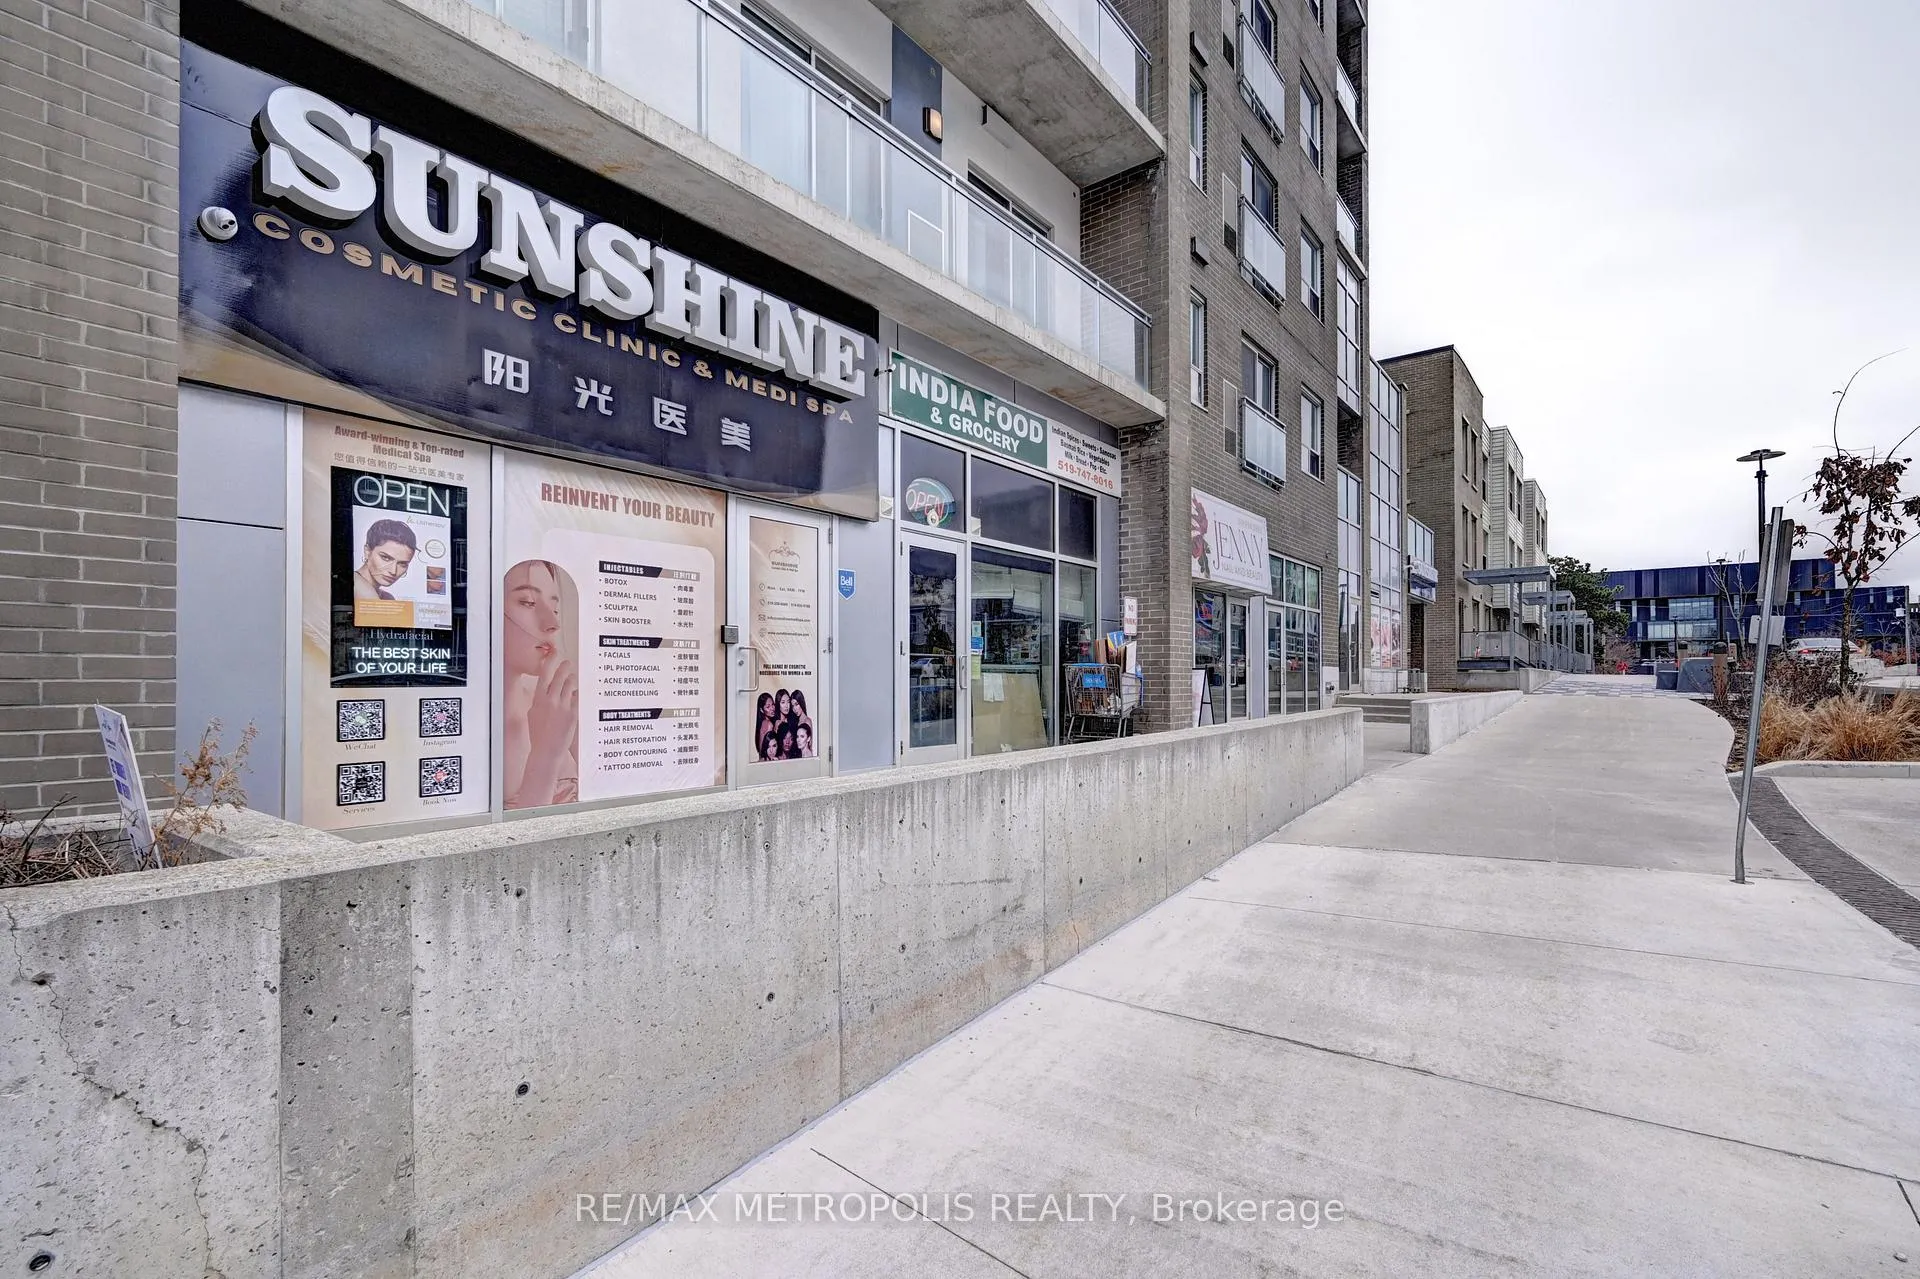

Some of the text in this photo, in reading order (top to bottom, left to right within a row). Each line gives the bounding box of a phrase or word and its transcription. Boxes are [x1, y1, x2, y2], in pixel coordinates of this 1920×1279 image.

[263, 84, 866, 404] SUNSHINE
[253, 212, 854, 425] COSMETIC CLINIC & MEDI SPA
[483, 350, 752, 452] 阳光医美
[900, 362, 1044, 444] INDIA FOOD
[931, 407, 1020, 453] & GROCERY
[335, 426, 409, 450] Award-winning
[421, 442, 464, 458] Top-rated
[1052, 426, 1116, 460] Indian Spices Sweets Samosas
[373, 444, 431, 463] Medical Spa
[1065, 451, 1073, 460] Milk
[1077, 447, 1085, 456] Rice
[1089, 452, 1110, 466] Vegetables
[1057, 461, 1113, 489] 519-747-8016
[354, 476, 450, 516] OPEN
[542, 483, 715, 528] REINVENT YOUR BEAUTY
[906, 489, 945, 519] OPEN
[1213, 520, 1263, 570] JENNY
[603, 564, 644, 574] INJECTABLES
[605, 578, 628, 586] BOTOX
[841, 576, 852, 586] Bell
[604, 591, 631, 599] DERMAL
[604, 604, 638, 612] SCULPTRA
[370, 630, 434, 643] Hydrafacial
[352, 647, 451, 659] THE BEST SKIN
[356, 662, 447, 673] OF YOUR LIFE
[618, 711, 651, 719] TREATMENTS
[623, 736, 667, 744] RESTORATION
[624, 748, 667, 756] CONTOURING
[344, 806, 375, 814] Services
